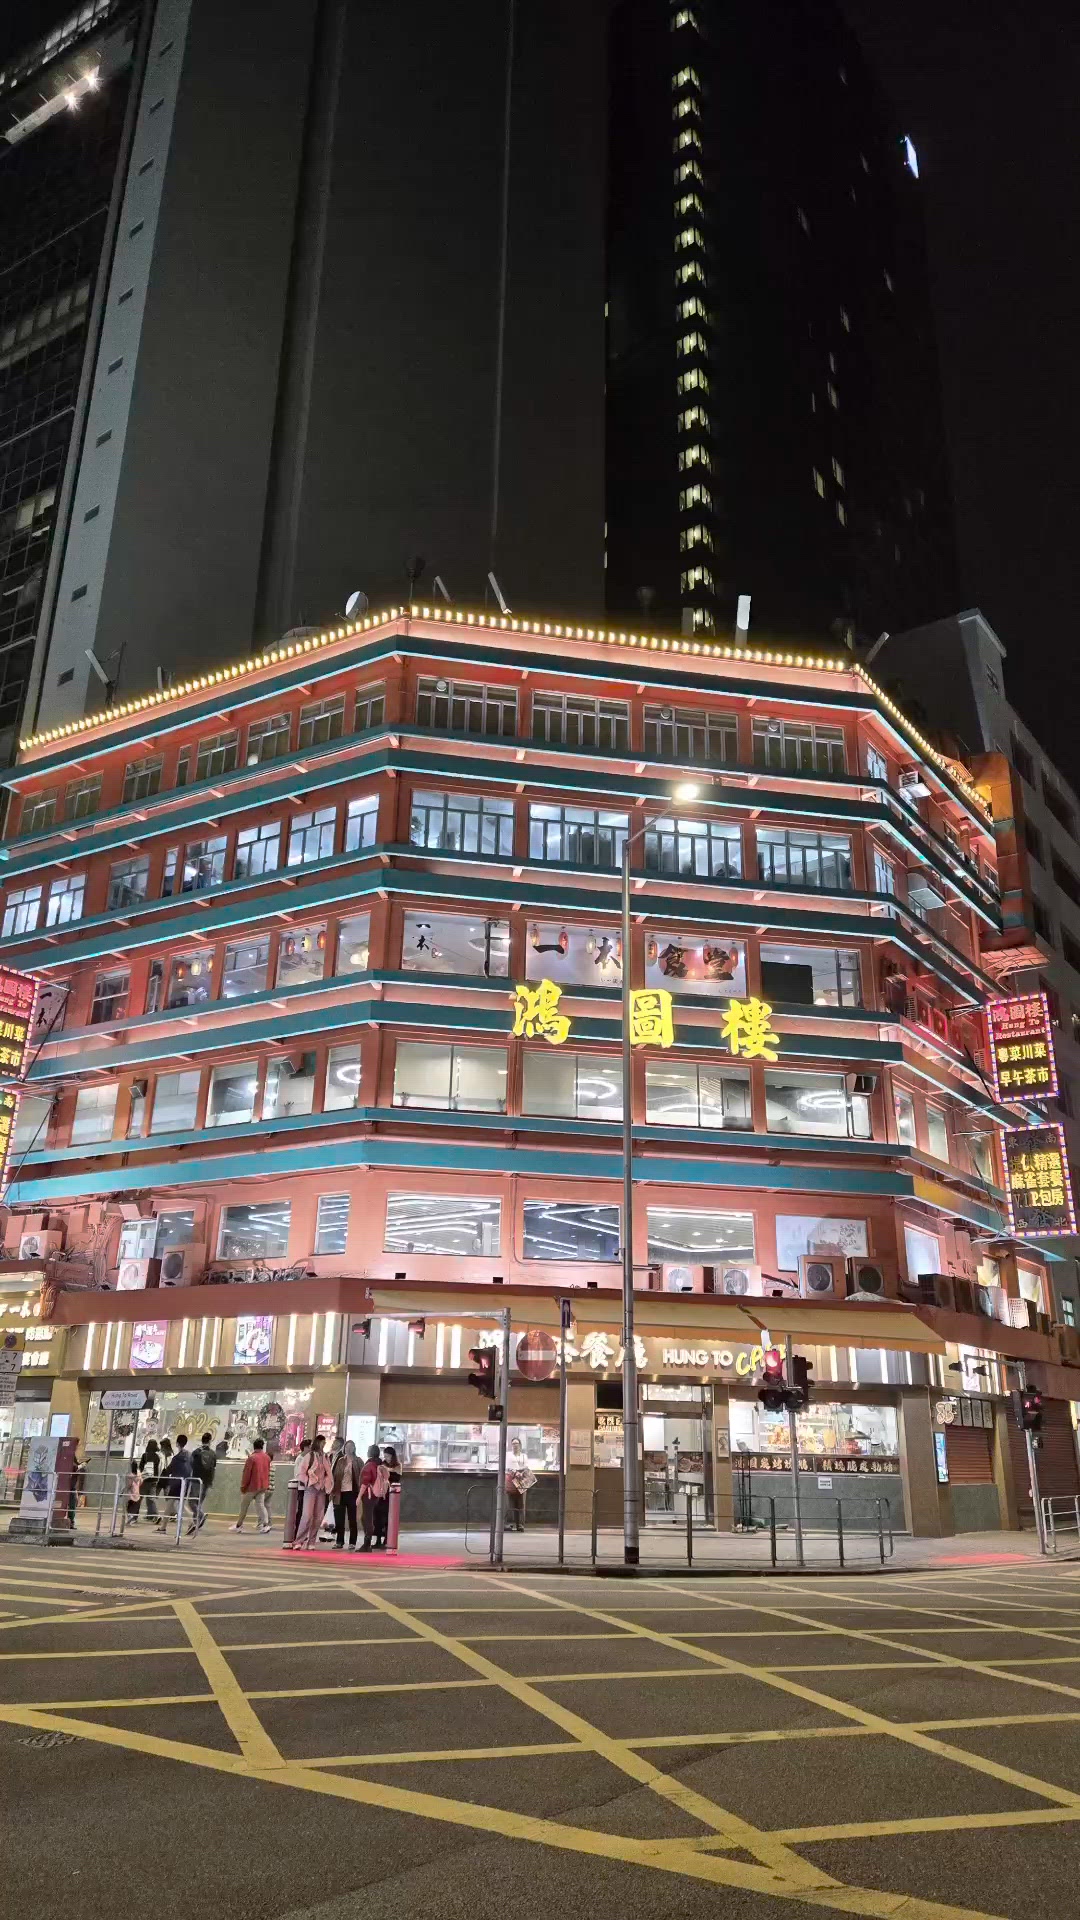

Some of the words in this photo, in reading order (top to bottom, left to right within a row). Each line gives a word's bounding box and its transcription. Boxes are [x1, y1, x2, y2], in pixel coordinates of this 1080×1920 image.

[513, 979, 781, 1062] 鴻圖樓
[992, 1001, 1044, 1022] 鴻圖樓
[1028, 1018, 1040, 1026] To
[995, 1026, 1046, 1040] Restaurant
[1000, 1066, 1049, 1087] 早午茶市
[662, 1348, 709, 1366] HUNG
[711, 1349, 734, 1367] TO
